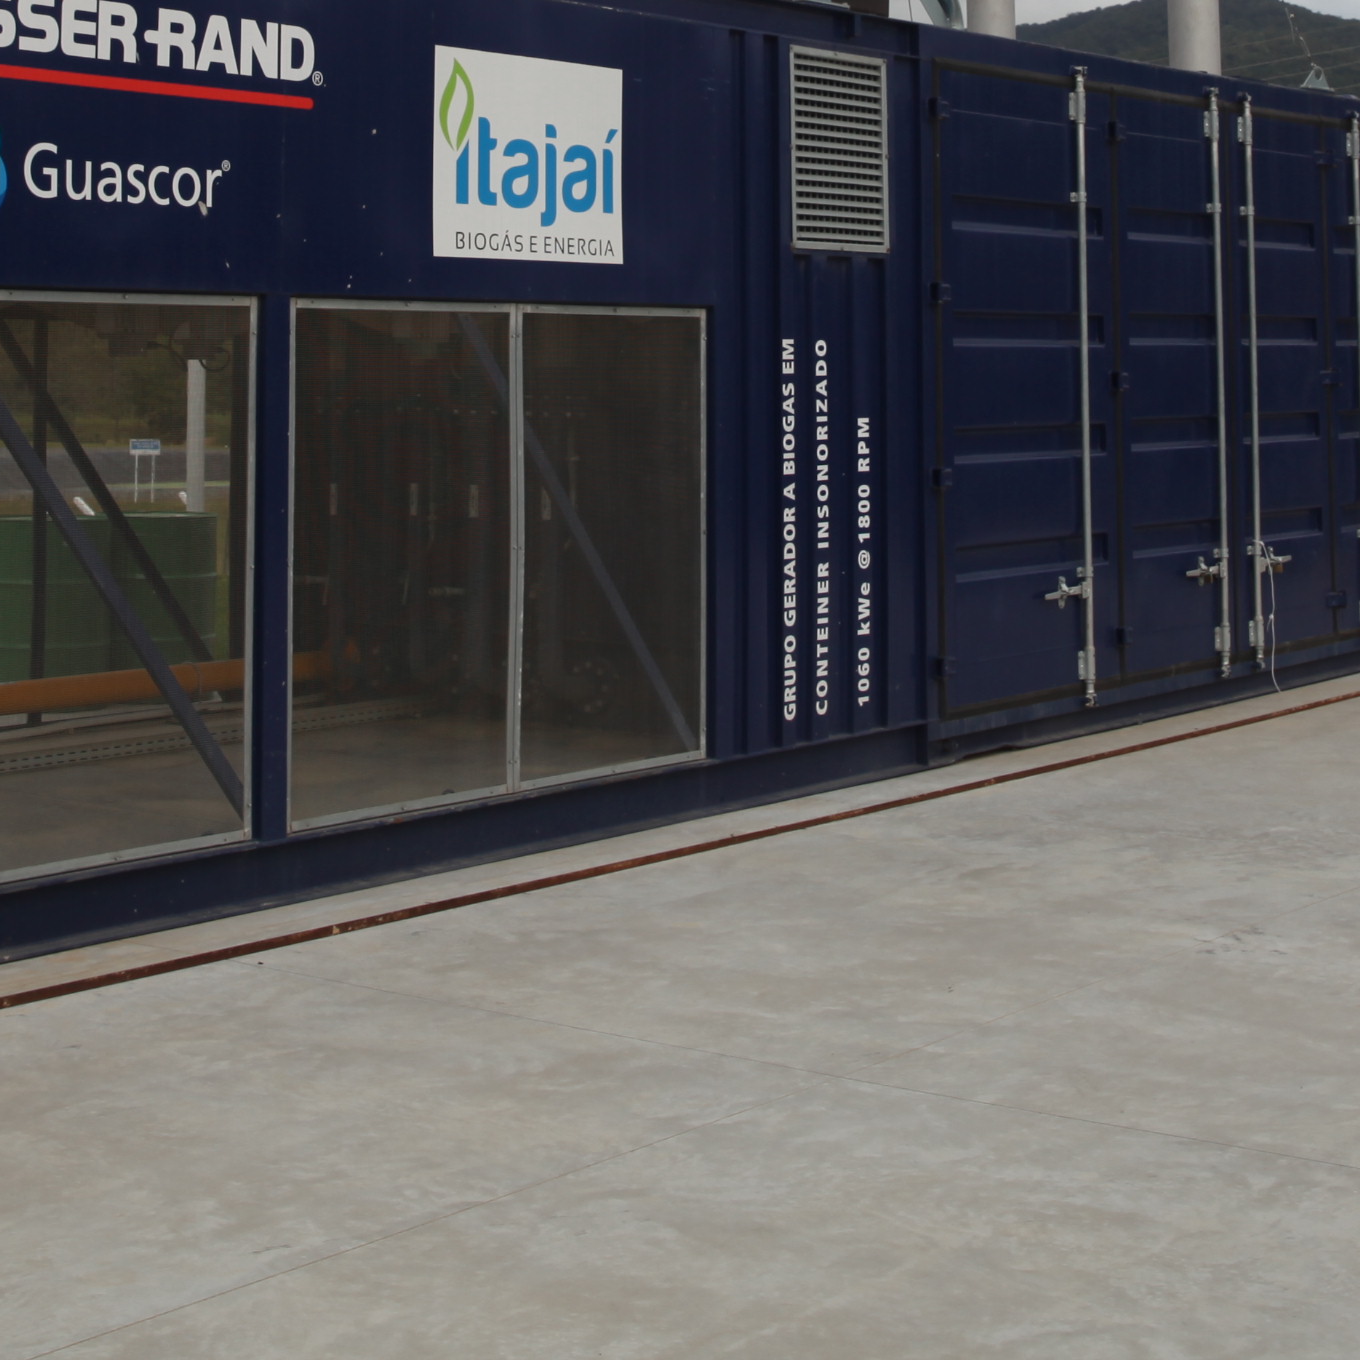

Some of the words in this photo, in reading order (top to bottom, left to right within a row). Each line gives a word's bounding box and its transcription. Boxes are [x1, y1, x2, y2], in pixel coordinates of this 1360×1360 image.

[455, 230, 524, 253] BIOGÁS
[529, 235, 538, 253] E
[543, 236, 615, 257] ENERGIA
[781, 338, 795, 375] EM
[782, 382, 796, 475] BIOGAS
[814, 339, 829, 549] INSONORIZADO
[857, 416, 871, 472] RPM
[783, 482, 796, 501] A
[783, 506, 797, 627] GERADOR
[815, 561, 830, 716] CONTEINER
[857, 581, 871, 636] kWe
[783, 634, 797, 721] GRUPO
[857, 647, 871, 707] 1060
